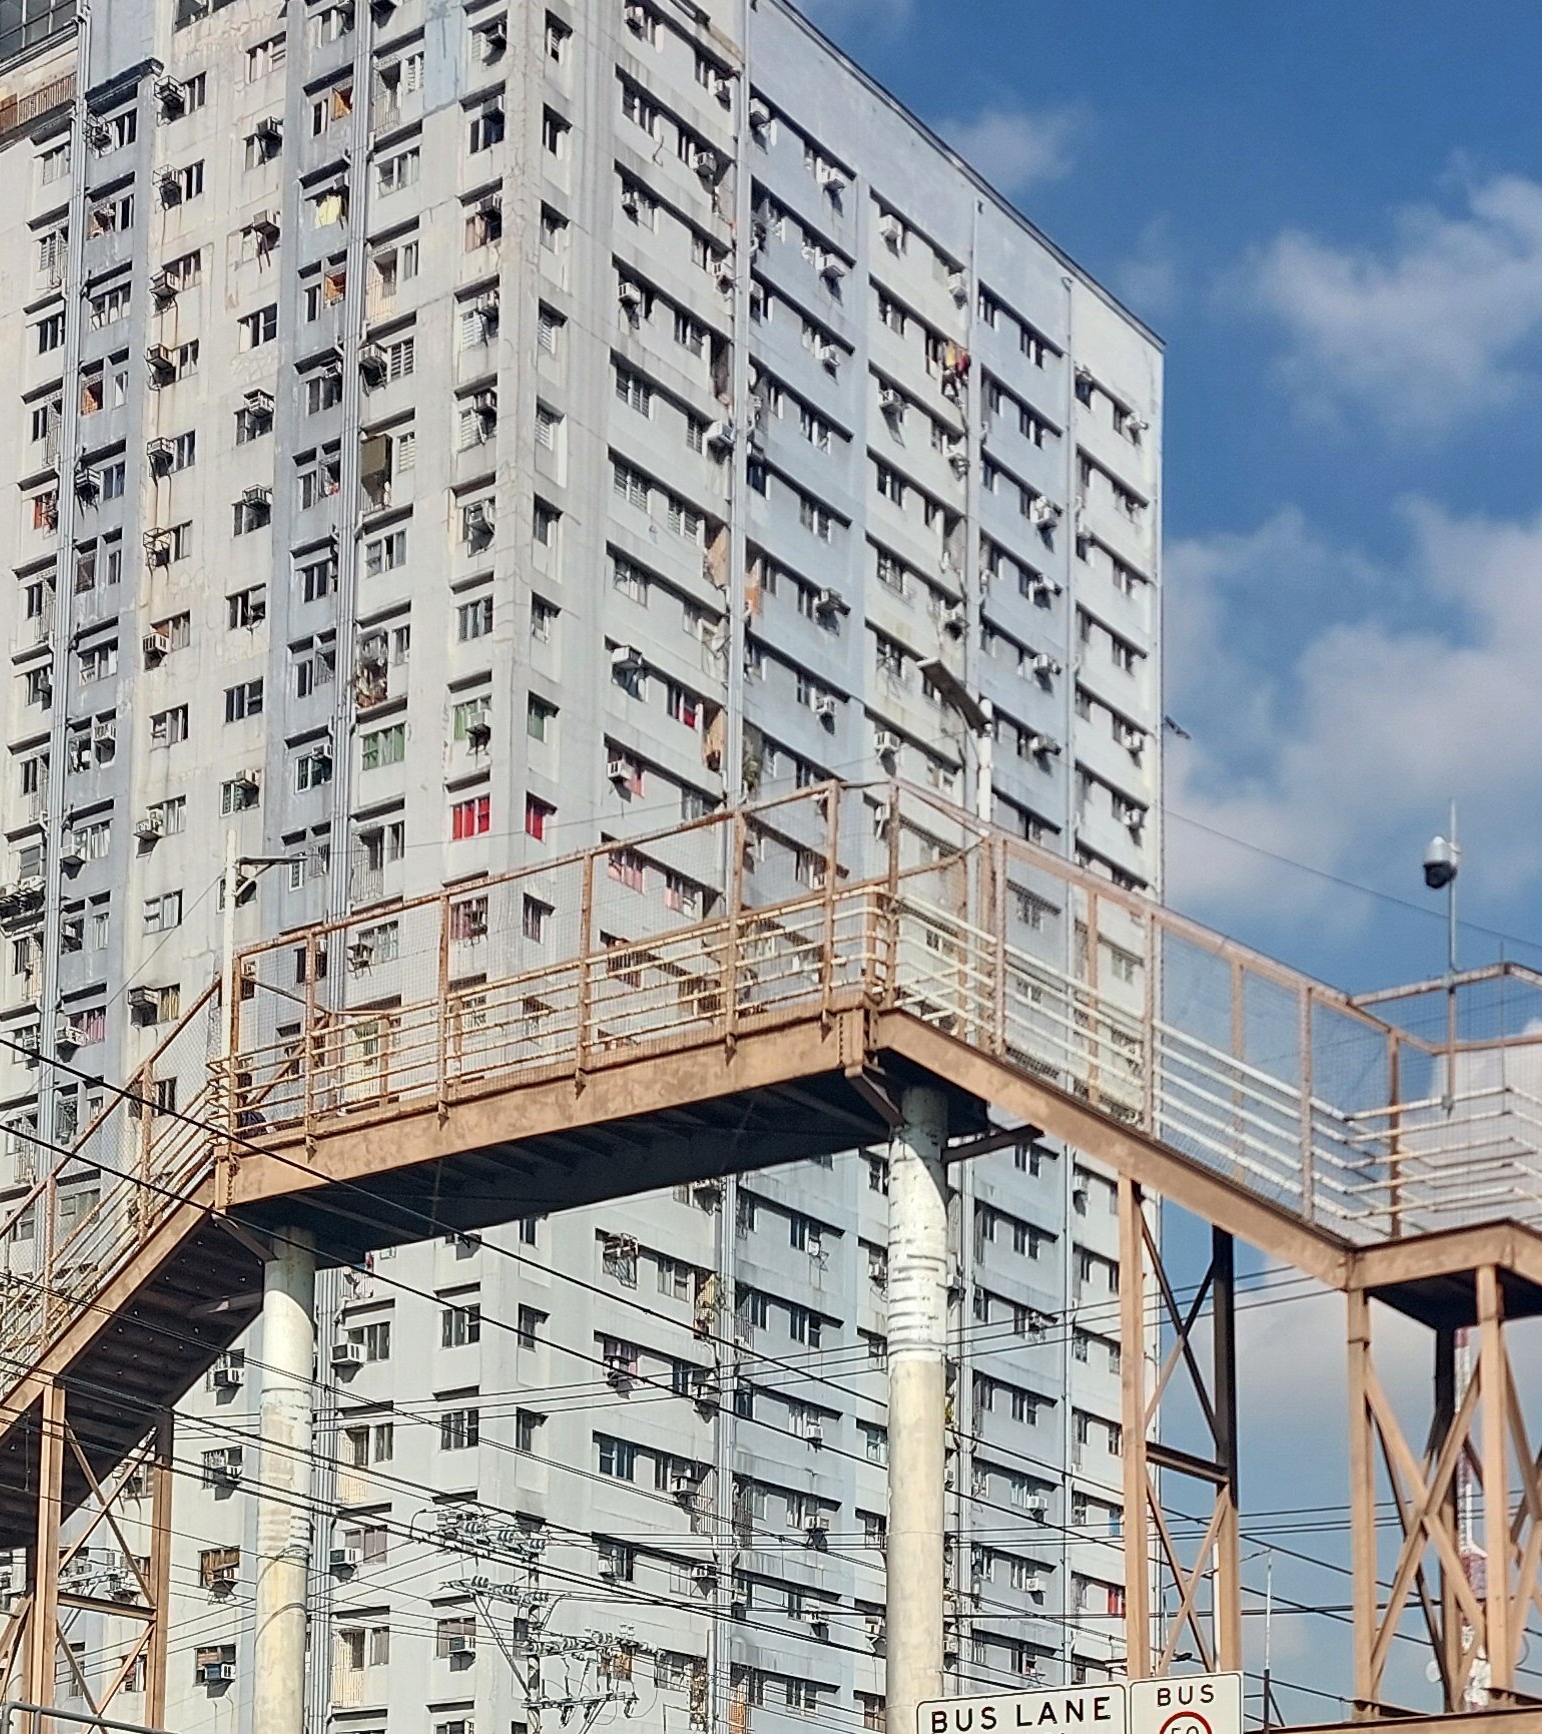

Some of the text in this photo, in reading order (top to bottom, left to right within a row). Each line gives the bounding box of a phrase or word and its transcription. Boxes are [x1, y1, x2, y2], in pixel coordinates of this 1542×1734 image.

[1157, 1684, 1214, 1707] BUS
[931, 1696, 1111, 1734] BUS LANE
